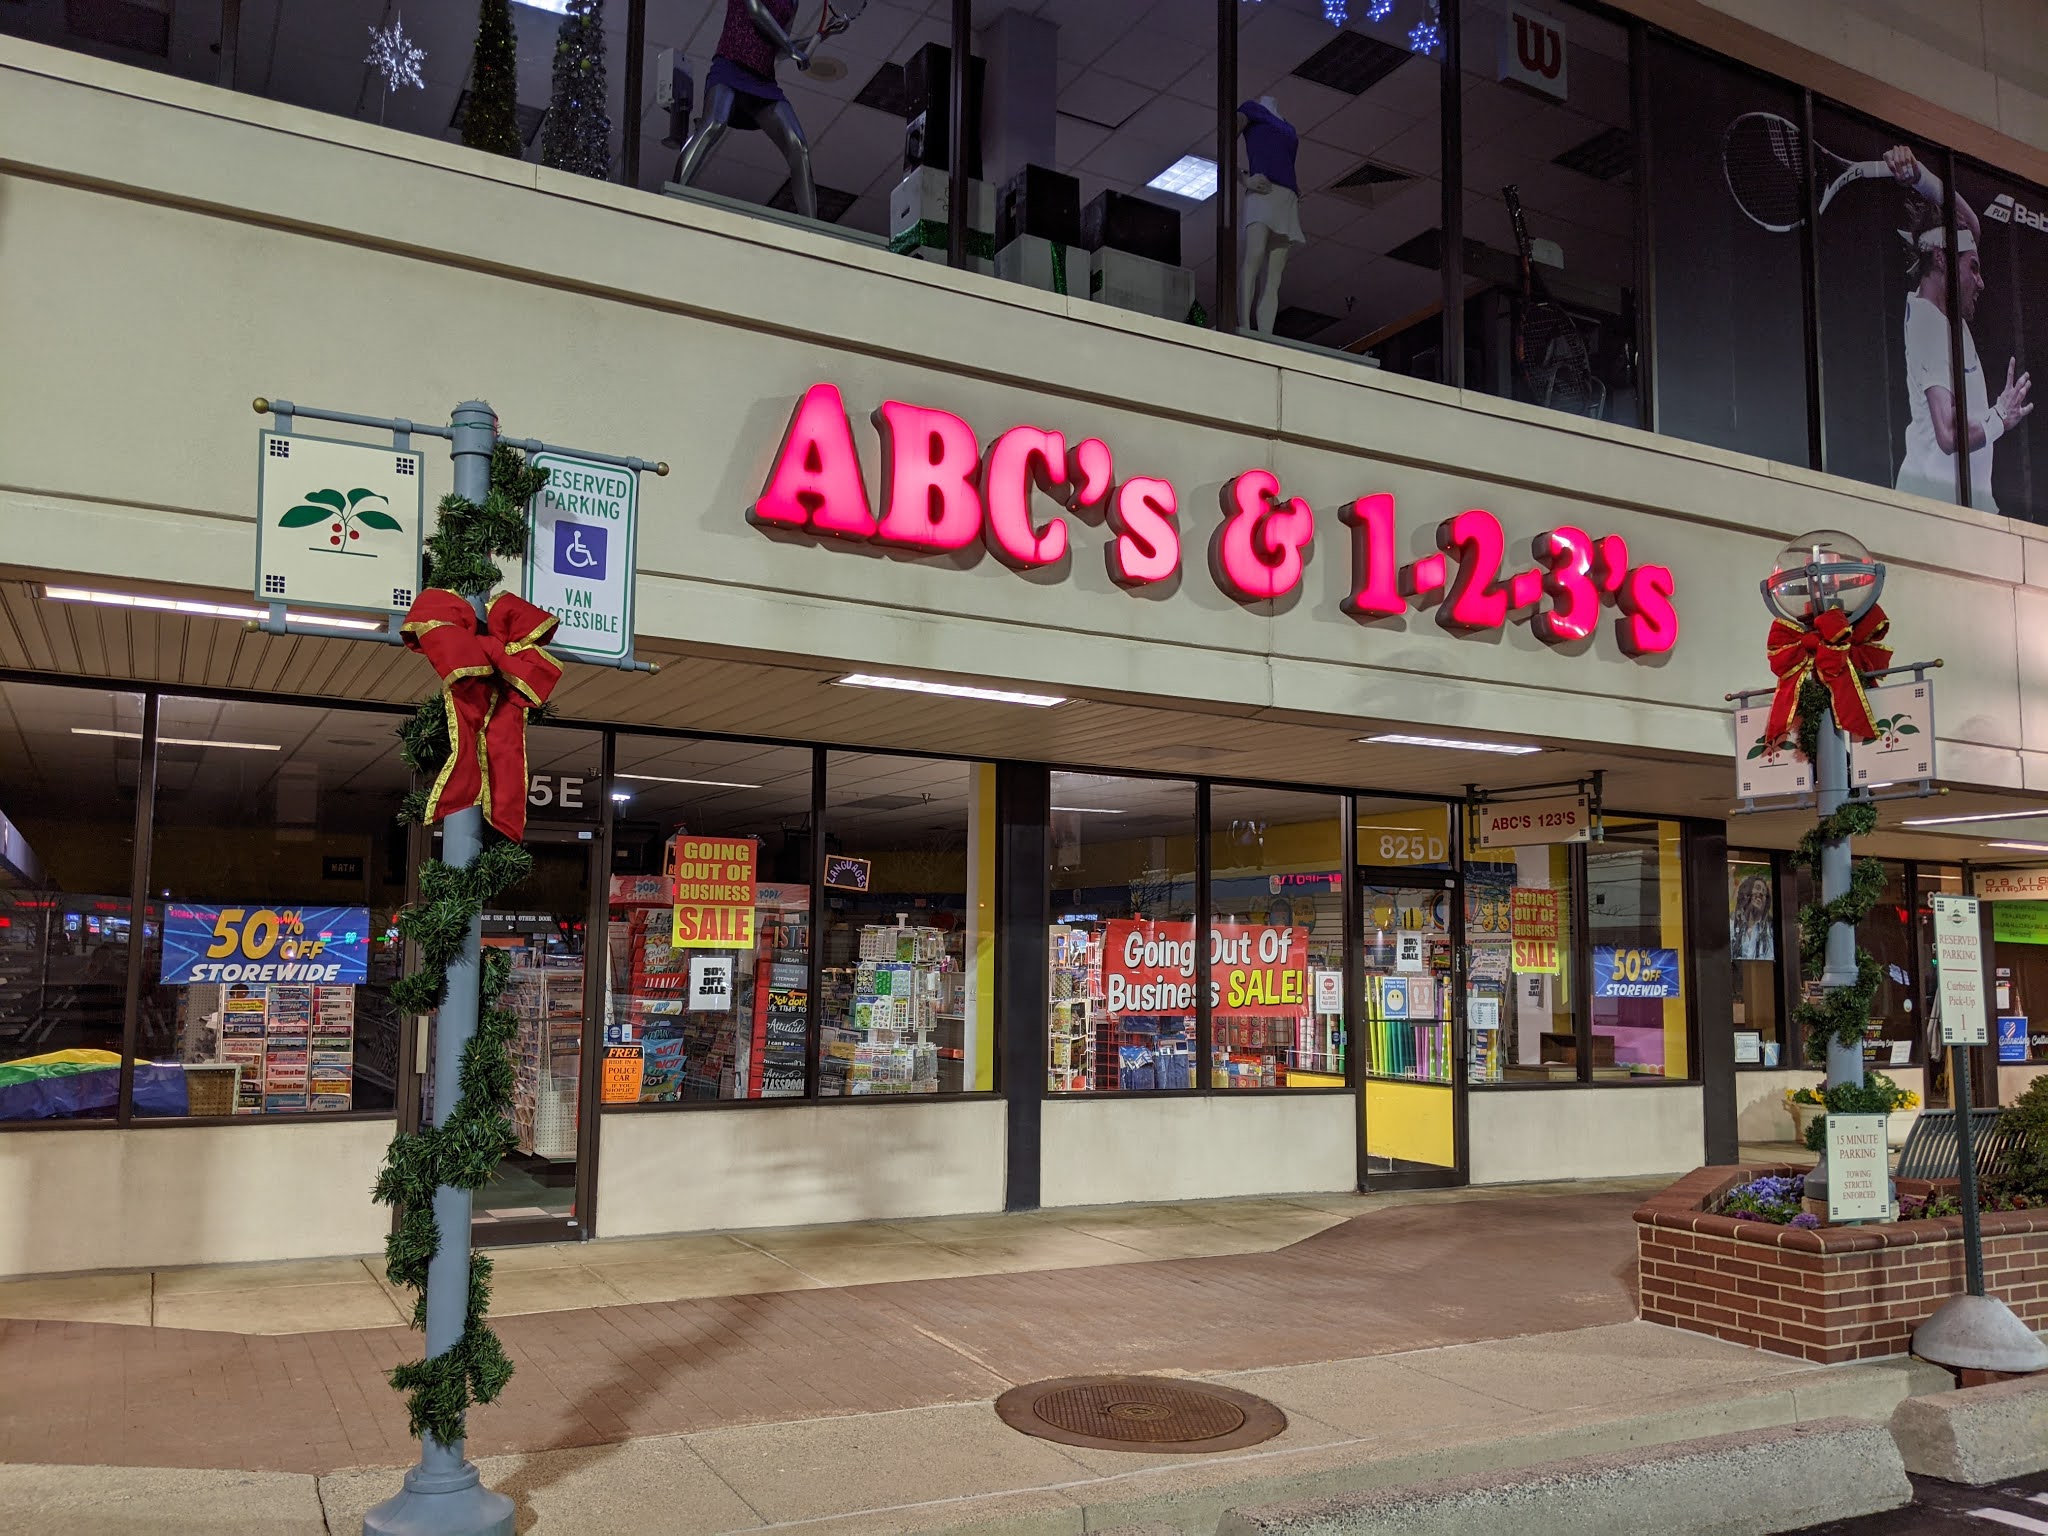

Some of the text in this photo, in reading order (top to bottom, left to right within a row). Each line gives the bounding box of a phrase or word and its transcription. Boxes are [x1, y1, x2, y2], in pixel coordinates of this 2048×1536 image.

[545, 490, 620, 519] PARKING
[750, 382, 1678, 652] ABC's & 1-2-3's
[565, 588, 592, 608] VAN
[1491, 811, 1575, 830] ABC'S 123'S
[684, 842, 749, 861] GOING
[331, 864, 355, 872] MATH
[681, 862, 751, 881] OUT OF
[827, 860, 866, 888] LANGUAGES
[680, 884, 750, 901] BUSINESS
[1515, 892, 1554, 906] GOING
[1514, 908, 1556, 922] OUT OF
[679, 907, 749, 941] SALE
[1514, 924, 1556, 937] BUSINESS
[206, 908, 305, 960] 50%
[1939, 934, 1978, 946] RESERVED
[279, 941, 326, 960] OFF
[1125, 931, 1196, 977] Going
[1259, 928, 1293, 963] Of
[1515, 941, 1557, 968] SALE
[1942, 949, 1976, 960] PARKING
[703, 967, 726, 976] 50%
[1611, 949, 1652, 981] 50%
[188, 963, 342, 982] STOREWIDE
[1642, 969, 1662, 981] OFF
[703, 977, 723, 985] OFF
[1946, 981, 1976, 991] Curbside
[699, 986, 726, 995] SALE
[1228, 969, 1303, 1008] SALE!
[1606, 983, 1669, 996] STOREWIDE
[1949, 996, 1976, 1008] Pick-Up
[766, 1018, 806, 1034] Attitude
[1961, 1014, 1966, 1030] 1
[1999, 1034, 2031, 1047] Connecting
[608, 1048, 640, 1058] FREE
[1837, 1134, 1879, 1145] 15 MINUTE
[1840, 1148, 1876, 1159] PARKING
[1846, 1170, 1871, 1178] TOWING
[1844, 1181, 1872, 1189] STRICTLY
[1842, 1190, 1876, 1200] ENFORCED
